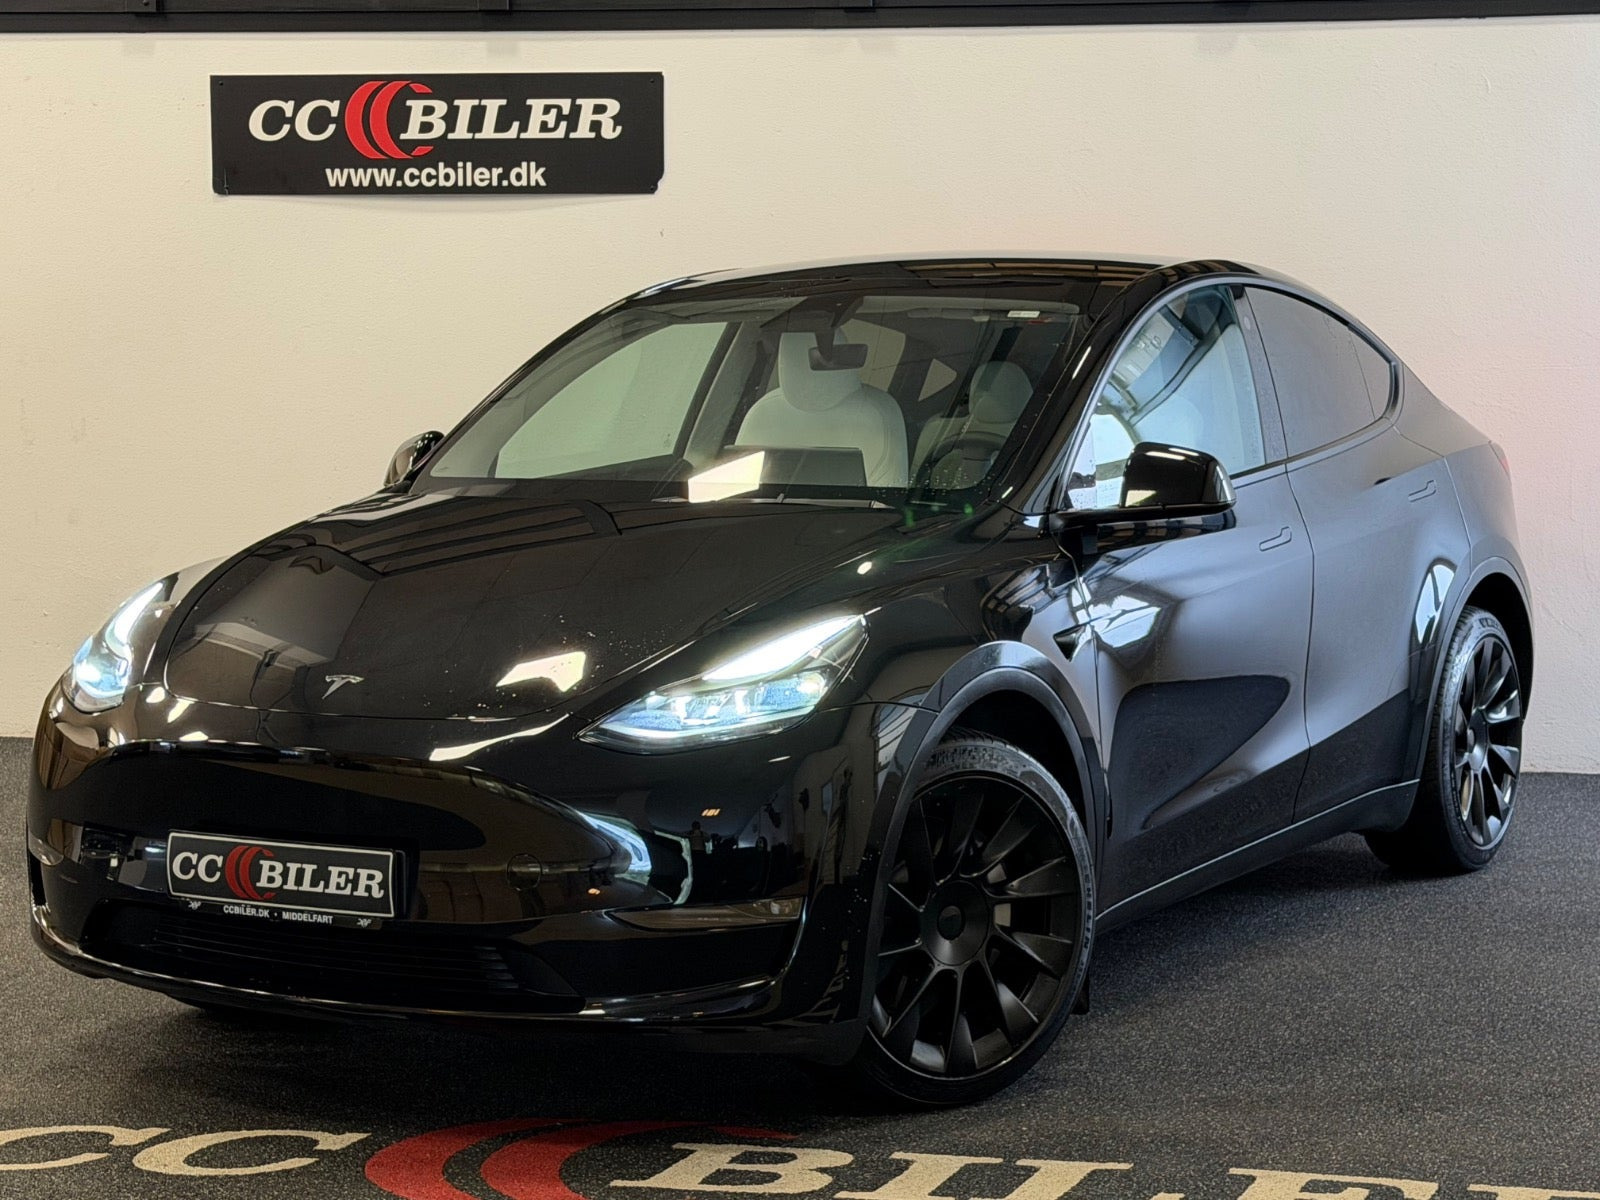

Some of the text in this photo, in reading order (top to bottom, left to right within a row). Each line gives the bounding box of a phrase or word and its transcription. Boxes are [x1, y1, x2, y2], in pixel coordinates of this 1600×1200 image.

[248, 98, 623, 142] CC BILER
[325, 161, 547, 187] www.ccbiler.dk
[172, 852, 385, 899] CC BILER
[223, 904, 334, 925] CCBILER.DK MIDDELFART
[609, 1142, 1600, 1200] BILE
